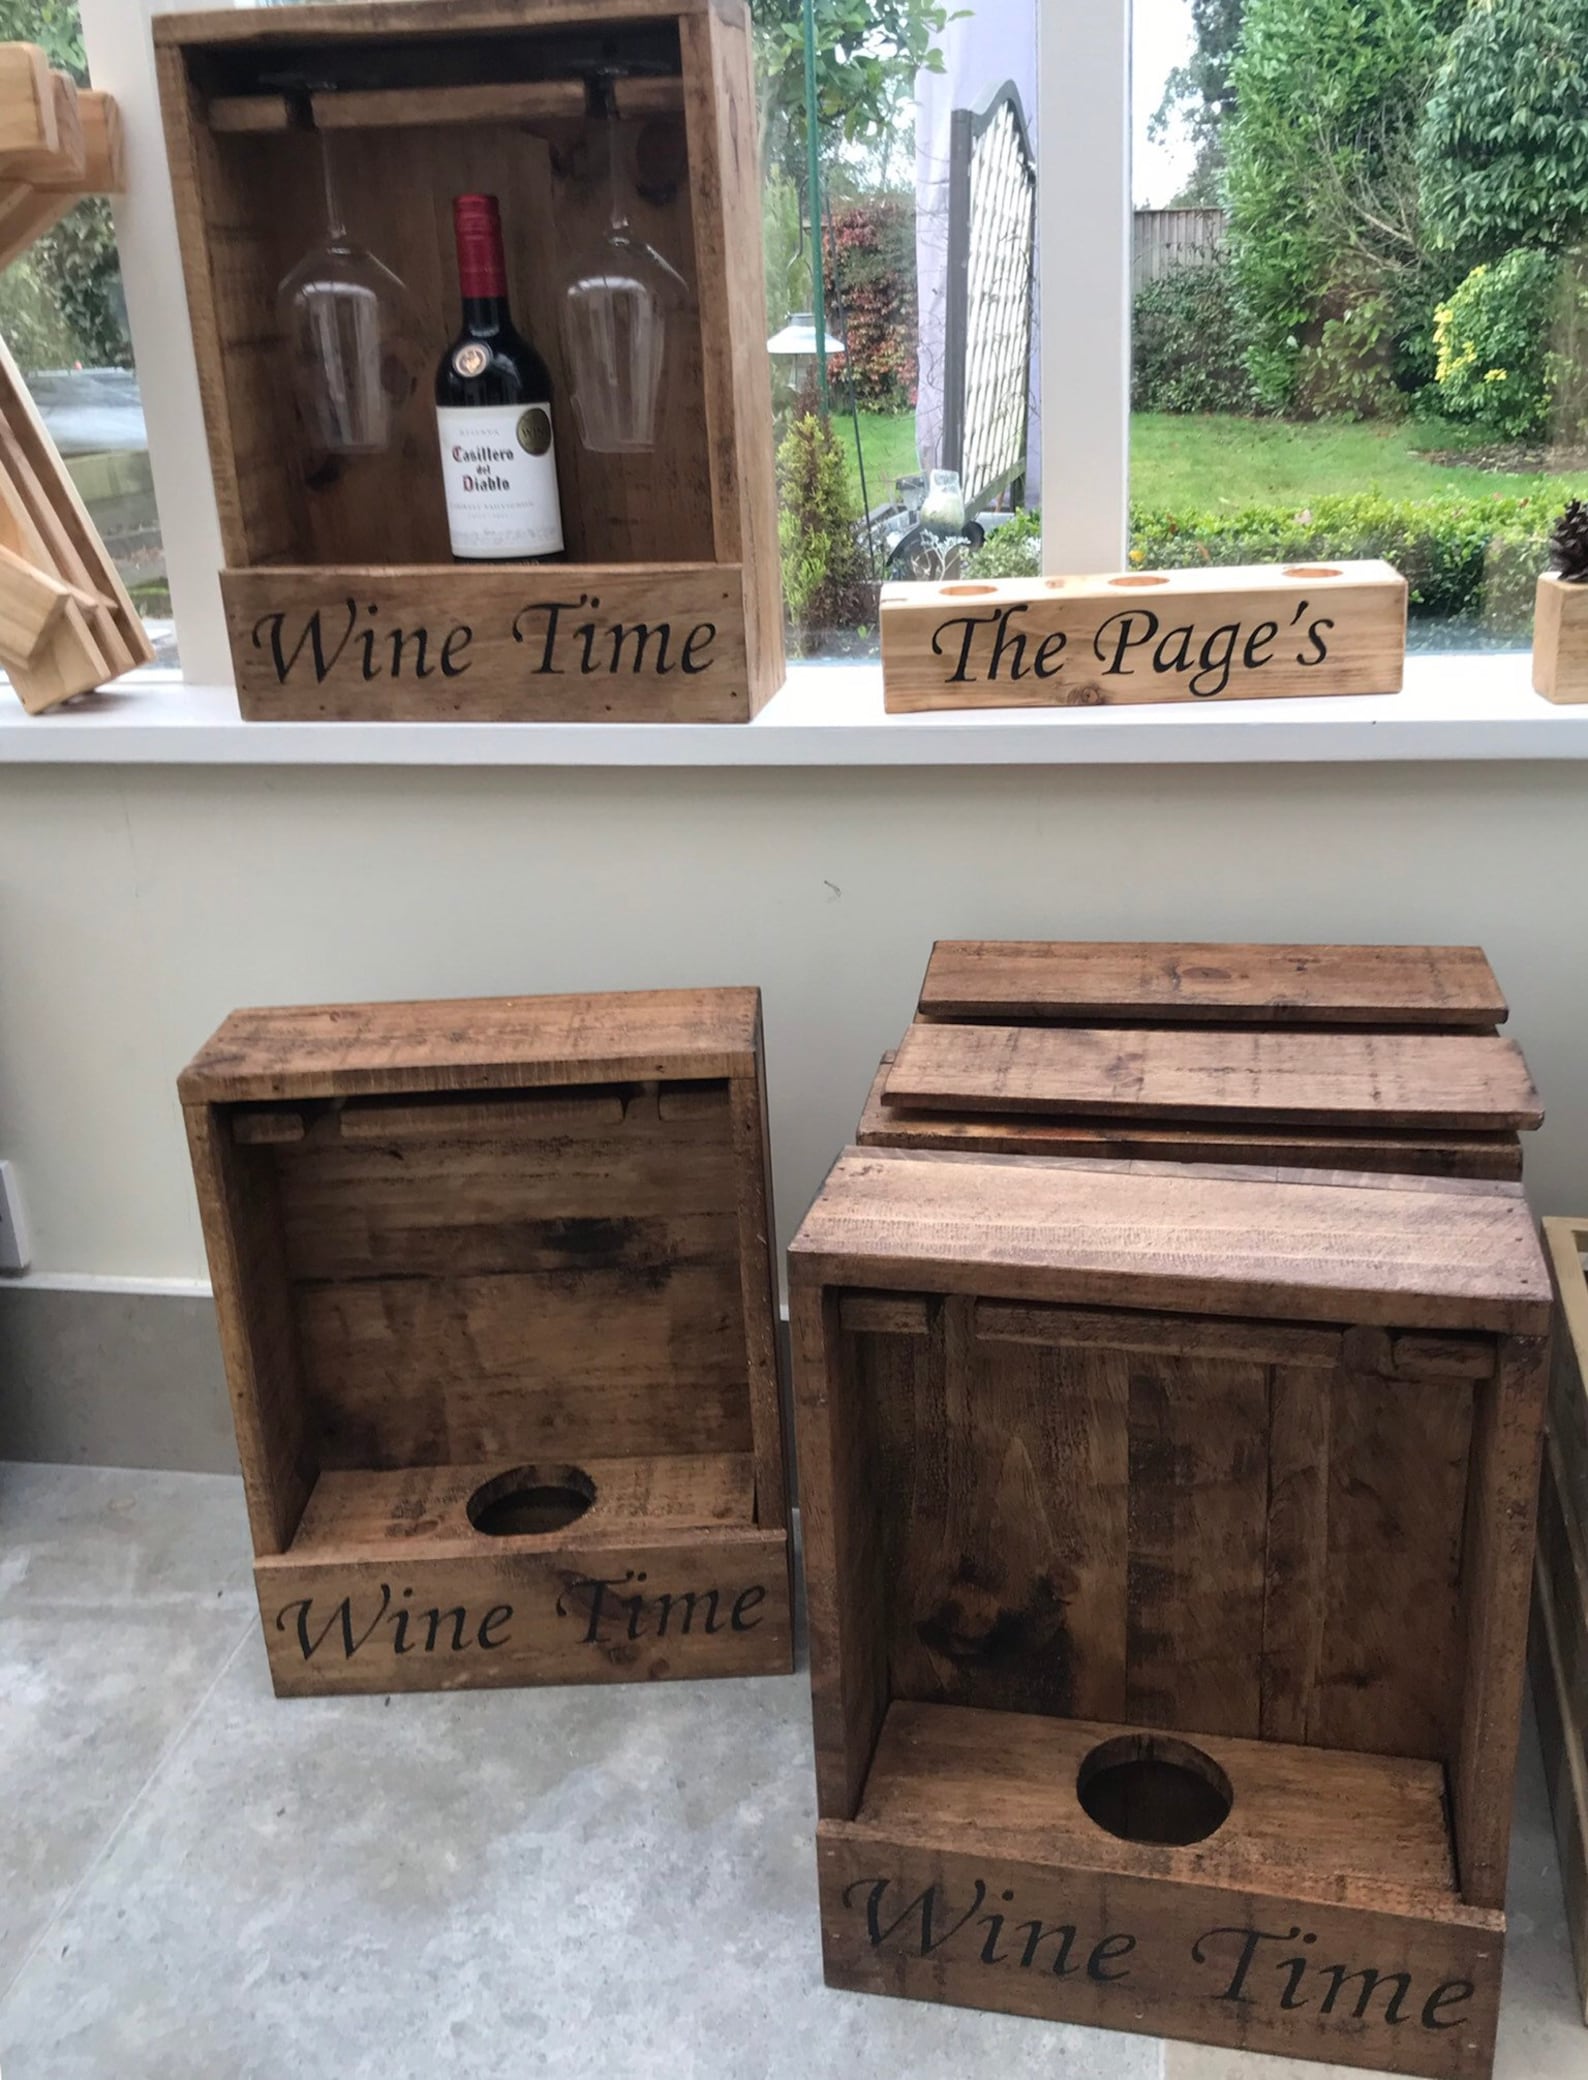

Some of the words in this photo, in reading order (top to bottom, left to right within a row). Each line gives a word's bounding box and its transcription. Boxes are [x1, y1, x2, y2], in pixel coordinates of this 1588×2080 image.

[452, 445, 514, 463] Casillero
[462, 475, 510, 492] Diablo
[476, 464, 491, 475] del
[251, 597, 473, 684] Wine
[512, 594, 717, 675] Time
[931, 604, 1068, 683] The
[1093, 600, 1334, 697] Page's
[276, 1583, 514, 1661] Wine
[555, 1569, 767, 1645] Time
[841, 1877, 1138, 1982] Wine
[1190, 1926, 1476, 2030] Time
